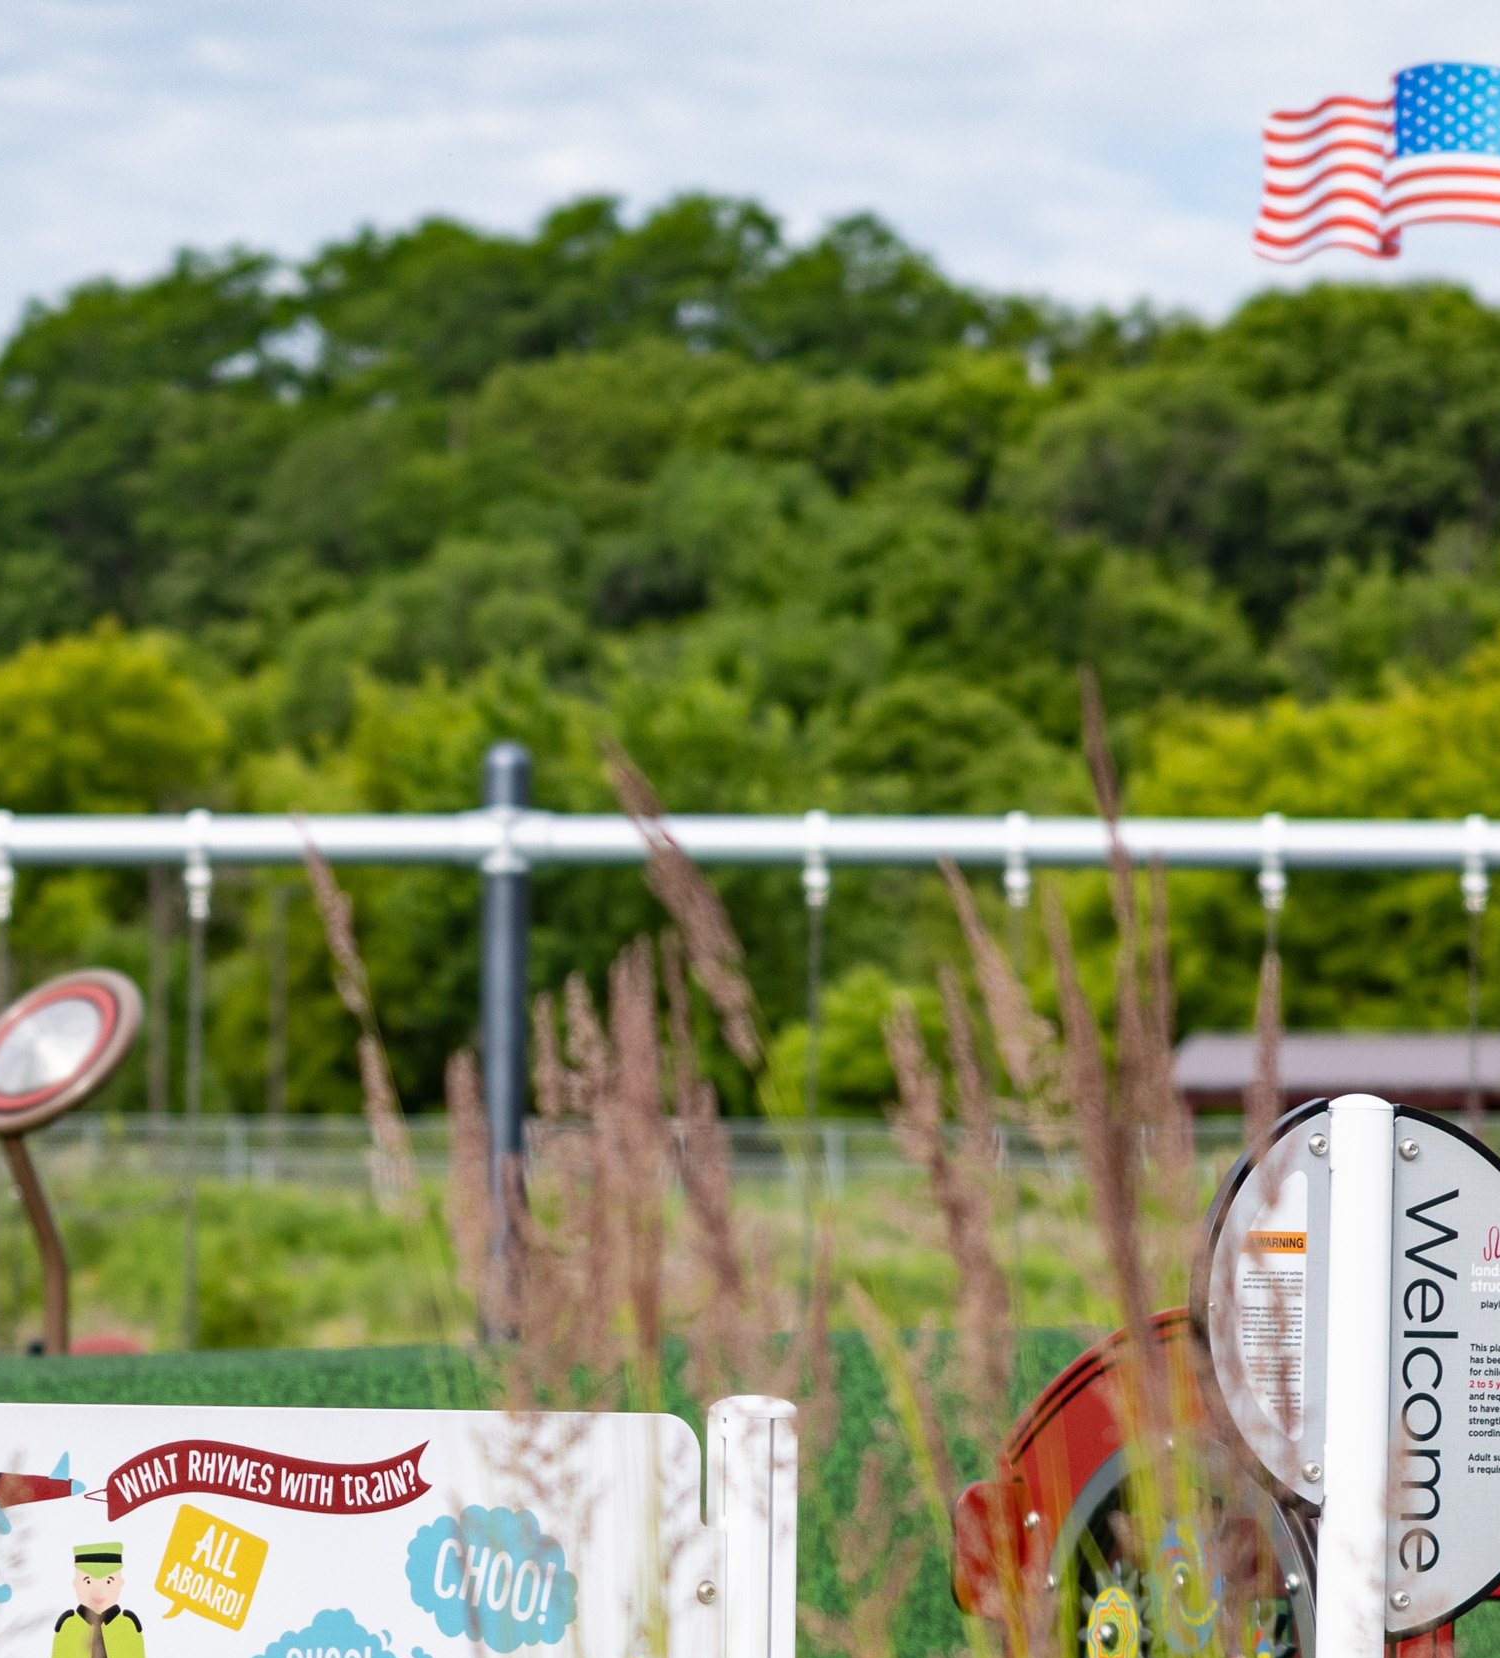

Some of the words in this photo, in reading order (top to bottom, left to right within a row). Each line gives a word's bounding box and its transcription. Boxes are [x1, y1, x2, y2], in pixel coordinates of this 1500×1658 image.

[1256, 1237, 1304, 1249] WARNING
[1470, 1343, 1487, 1352] This
[1469, 1356, 1484, 1364] has
[1469, 1368, 1482, 1376] for
[1398, 1188, 1460, 1574] Welcome
[1469, 1380, 1474, 1388] 2
[1477, 1380, 1486, 1388] to
[1488, 1380, 1493, 1388] 5
[1469, 1393, 1485, 1401] and
[1480, 1405, 1500, 1413] have
[1468, 1453, 1491, 1462] Adult
[1467, 1465, 1474, 1473] is
[114, 1453, 178, 1503] WHAT
[188, 1450, 274, 1495] RHYMES
[280, 1467, 334, 1506] WITH
[191, 1524, 240, 1579] ALL
[433, 1538, 556, 1625] CHOO!
[164, 1562, 246, 1621] ABOARD!
